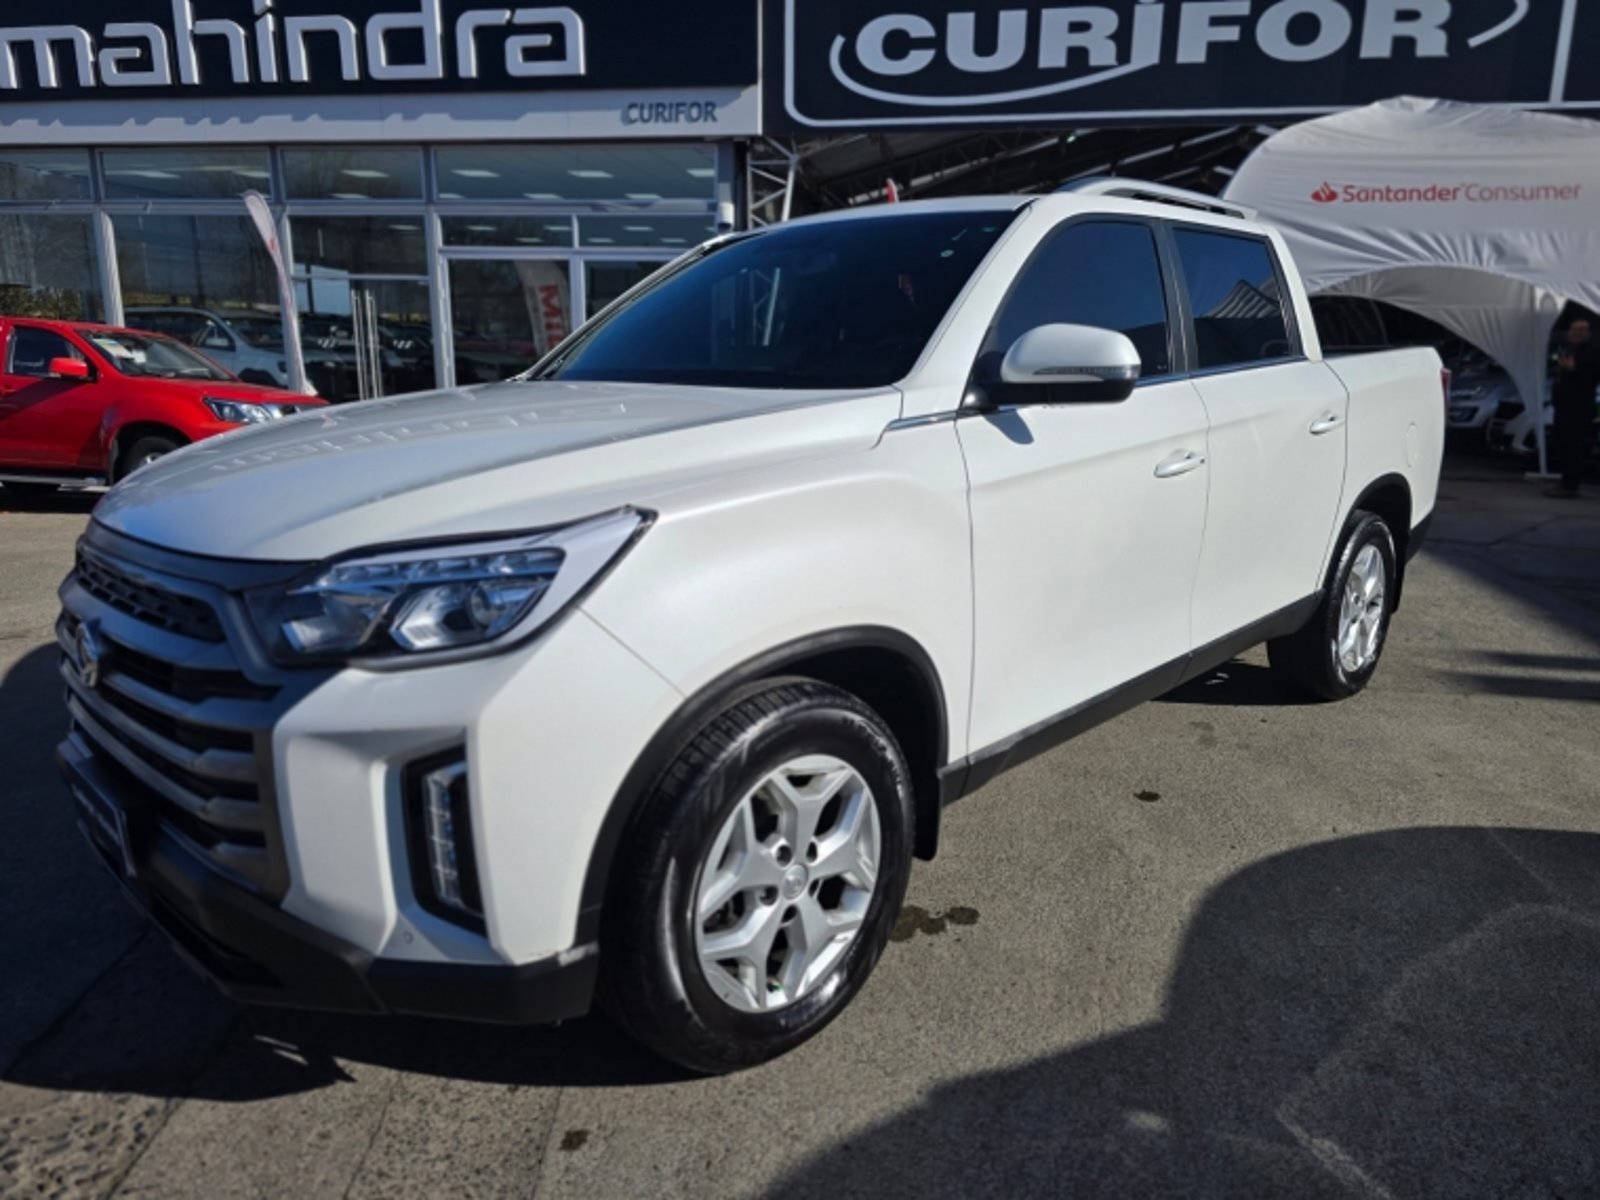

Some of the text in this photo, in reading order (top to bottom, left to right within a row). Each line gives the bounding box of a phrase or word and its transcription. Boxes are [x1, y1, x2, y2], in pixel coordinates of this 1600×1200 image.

[0, 0, 587, 89] mahindra
[622, 100, 719, 124] CURIFOR
[1342, 182, 1581, 204] Santander Consumer
